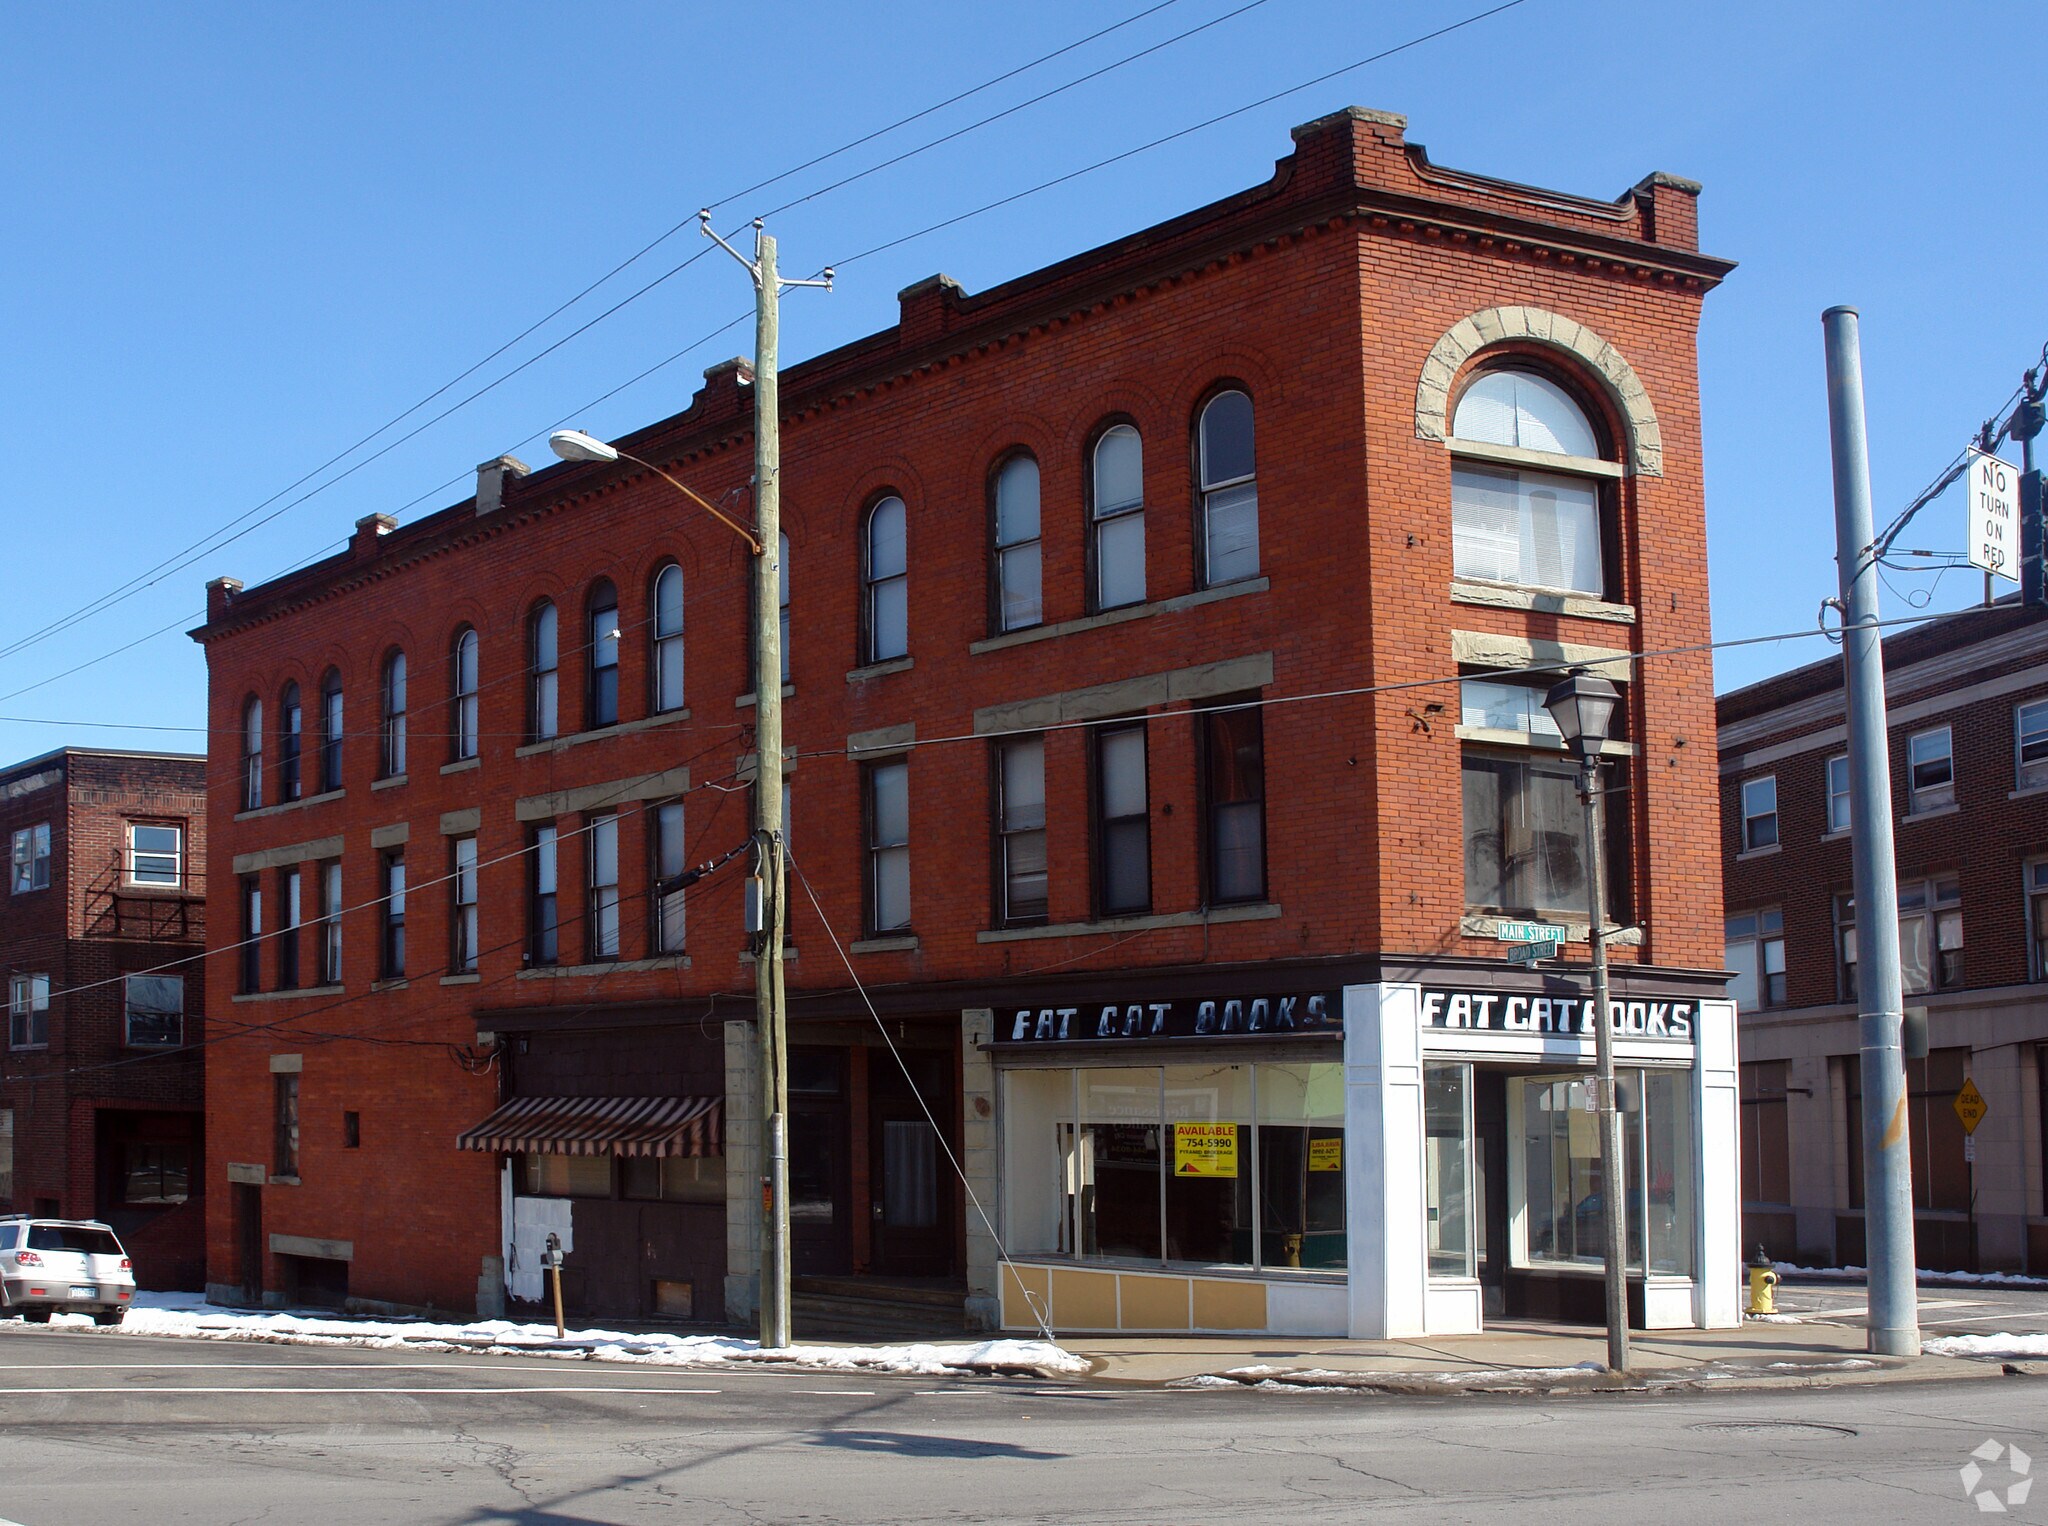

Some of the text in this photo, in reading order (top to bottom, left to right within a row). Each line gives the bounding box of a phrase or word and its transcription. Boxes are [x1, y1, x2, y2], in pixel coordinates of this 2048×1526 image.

[1983, 464, 2005, 493] NO
[1980, 492, 2009, 519] TURN
[1986, 520, 2003, 542] ON
[1983, 543, 2005, 568] RED
[1501, 924, 1562, 942] MAIN STREET
[1509, 942, 1554, 961] BROAD STREET
[1011, 995, 1327, 1040] FAT CAT BOOKS
[1421, 992, 1499, 1028] FAT
[1503, 996, 1578, 1032] CAT
[1961, 1094, 1979, 1104] DEAD
[1963, 1109, 1977, 1119] END
[1177, 1126, 1235, 1136] AVAILABLE
[1186, 1138, 1232, 1148] 754-5990
